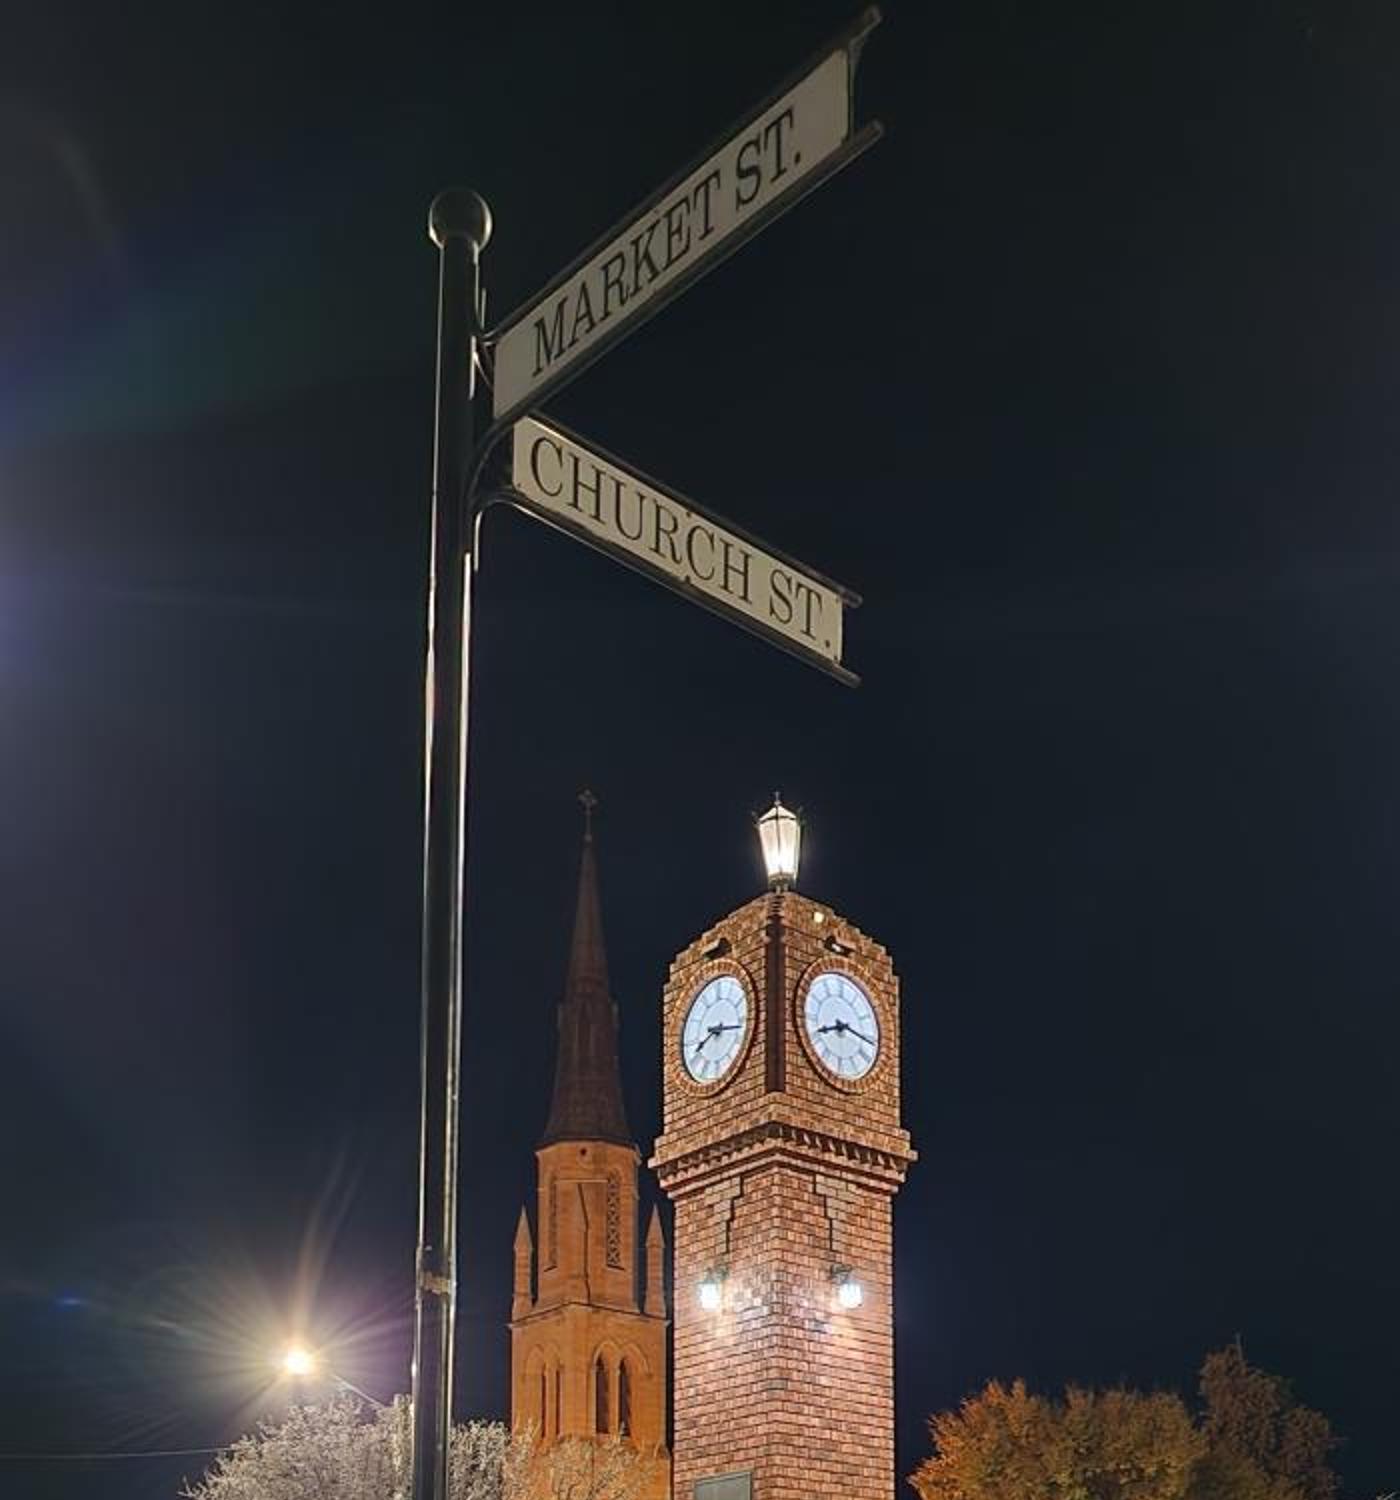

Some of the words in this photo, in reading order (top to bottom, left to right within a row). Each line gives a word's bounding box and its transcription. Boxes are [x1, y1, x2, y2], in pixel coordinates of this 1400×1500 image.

[533, 170, 721, 377] MARKET
[735, 109, 802, 210] ST.
[530, 437, 754, 605] CHURCH
[767, 568, 832, 649] ST.
